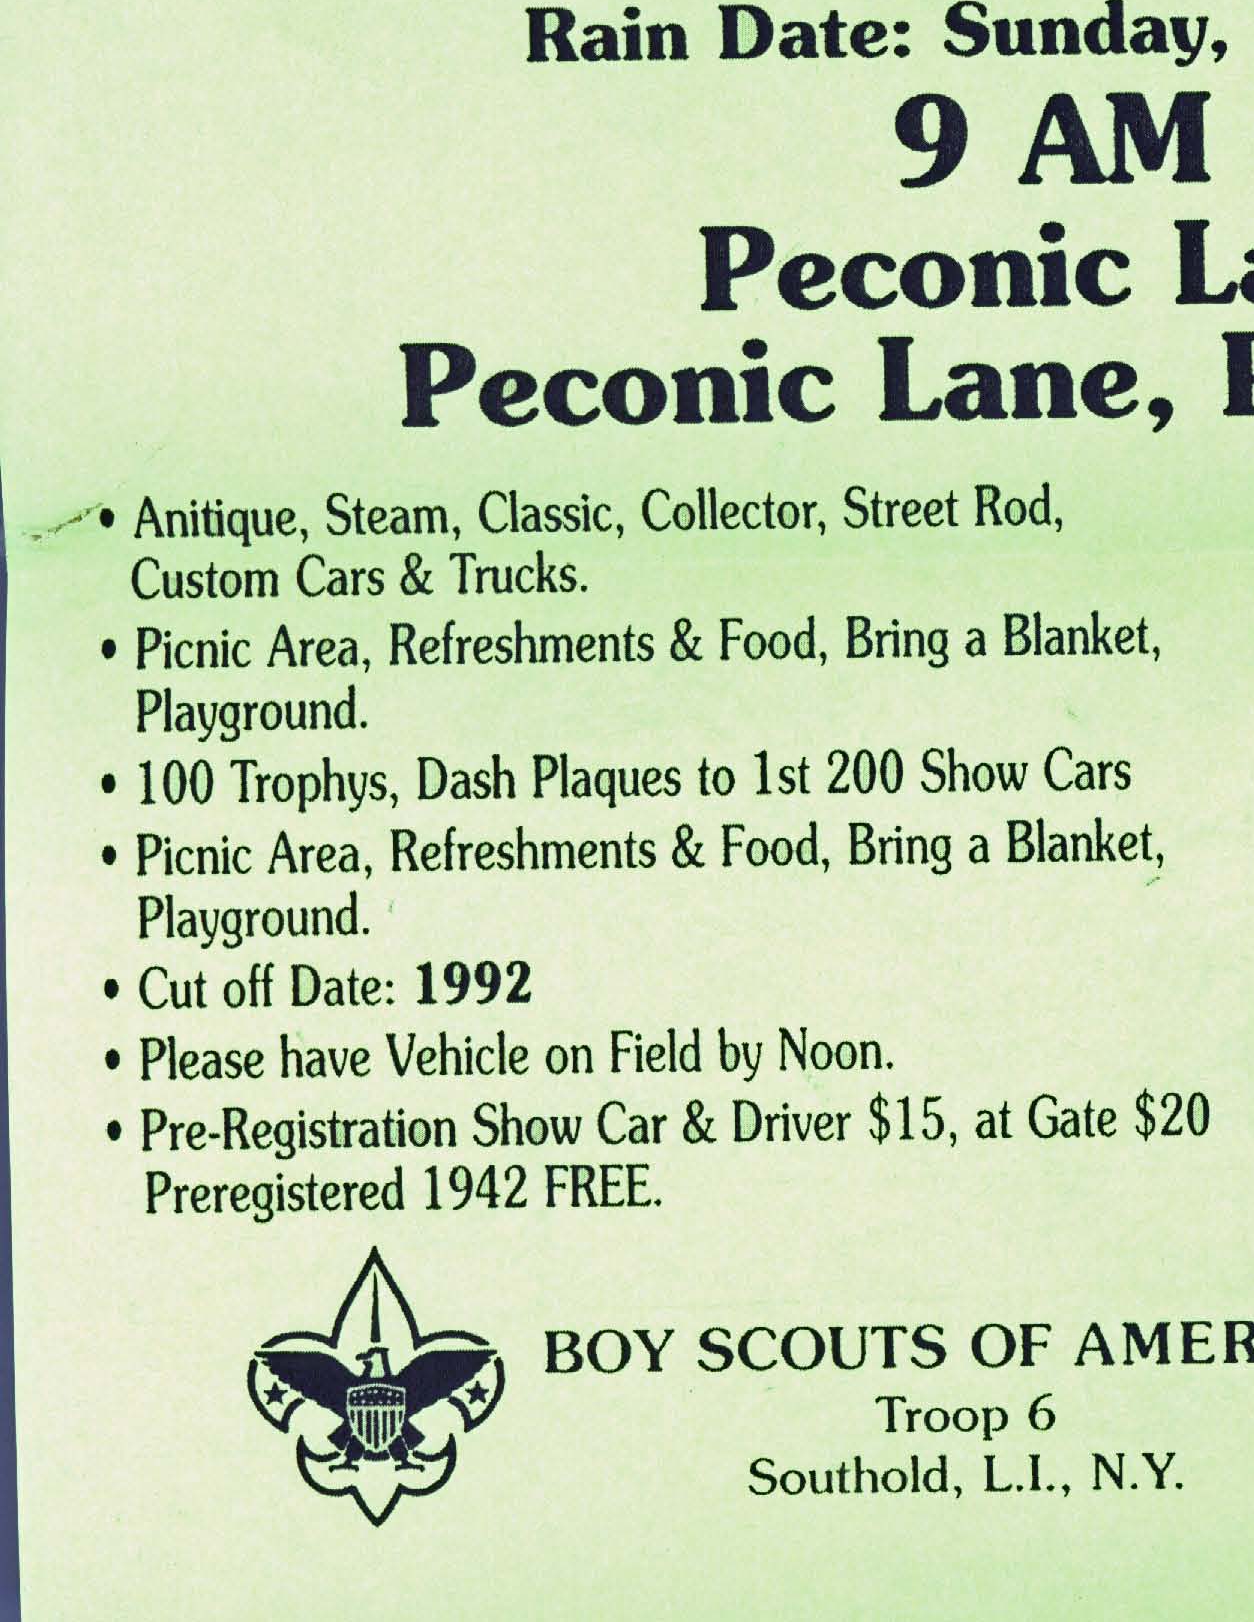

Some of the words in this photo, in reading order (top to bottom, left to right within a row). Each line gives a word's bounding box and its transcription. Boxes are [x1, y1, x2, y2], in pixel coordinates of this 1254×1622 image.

[524, 5, 691, 64] Rain
[717, 3, 912, 61] Date:
[893, 92, 970, 190] 9
[1016, 89, 1213, 186] AM
[697, 219, 1133, 313] Peconic
[397, 336, 837, 429] Peconic
[876, 335, 1175, 435] Lane,
[132, 494, 310, 549] Anitique,
[325, 491, 462, 542] Steam,
[477, 488, 625, 540] Classic,
[640, 485, 827, 537] Collector,
[842, 484, 960, 530] Street
[973, 480, 1064, 534] Rod,
[130, 555, 280, 601] Custom
[295, 552, 386, 599] Cars
[398, 551, 435, 597] &
[448, 548, 589, 596] Trucks.
[135, 625, 253, 672] Picnic
[265, 623, 372, 675] Area,
[388, 618, 656, 667] Refreshments
[668, 616, 704, 663] &
[718, 614, 828, 668] Food,
[845, 614, 950, 670] Bring
[963, 626, 988, 659] a
[1002, 608, 1161, 663] Blanket,
[135, 683, 369, 744] Playground.
[137, 758, 215, 807] 100
[228, 755, 400, 815] Trophys,
[416, 752, 517, 801] Dash
[531, 751, 683, 810] Plaques
[696, 756, 737, 798] to
[752, 748, 812, 796] 1st
[826, 747, 905, 796] 200
[919, 745, 1030, 795] Show
[1042, 744, 1132, 793] Cars
[135, 832, 253, 878] Picnic
[266, 829, 374, 881] Area,
[389, 824, 658, 873] Refreshments
[670, 822, 706, 870] &
[720, 819, 831, 875] Food,
[847, 821, 953, 877] Bring
[967, 833, 991, 866] a
[1005, 815, 1165, 870] Blanket,
[136, 888, 371, 951] Playground.
[137, 964, 209, 1011] Cut
[222, 960, 276, 1010] off
[289, 962, 396, 1008] Date:
[415, 959, 533, 1007] 1992
[138, 1034, 266, 1083] Please
[278, 1032, 372, 1080] have
[384, 1028, 530, 1078] Vehicle
[544, 1043, 595, 1076] on
[609, 1026, 703, 1075] Field
[716, 1025, 764, 1084] by
[777, 1025, 895, 1073] Noon.
[139, 1105, 458, 1161] Pre-Registration
[471, 1100, 583, 1149] Show
[596, 1099, 669, 1146] Car
[681, 1097, 718, 1146] &
[731, 1098, 853, 1144] Driver
[868, 1090, 958, 1149] $15,
[974, 1099, 1014, 1141] at
[1027, 1092, 1118, 1140] Gate
[1134, 1086, 1211, 1143] $20
[144, 1164, 406, 1225] Preregistered
[423, 1163, 529, 1212] 1942
[543, 1162, 663, 1209] FREE.
[543, 1327, 676, 1375] BOY
[696, 1322, 948, 1374] SCOUTS
[970, 1322, 1053, 1370] OF
[873, 1394, 1010, 1443] Troop
[1027, 1391, 1057, 1432] 6
[747, 1453, 963, 1500] Southold,
[982, 1453, 1072, 1499] L.I.,
[1090, 1451, 1184, 1492] N.Y.
